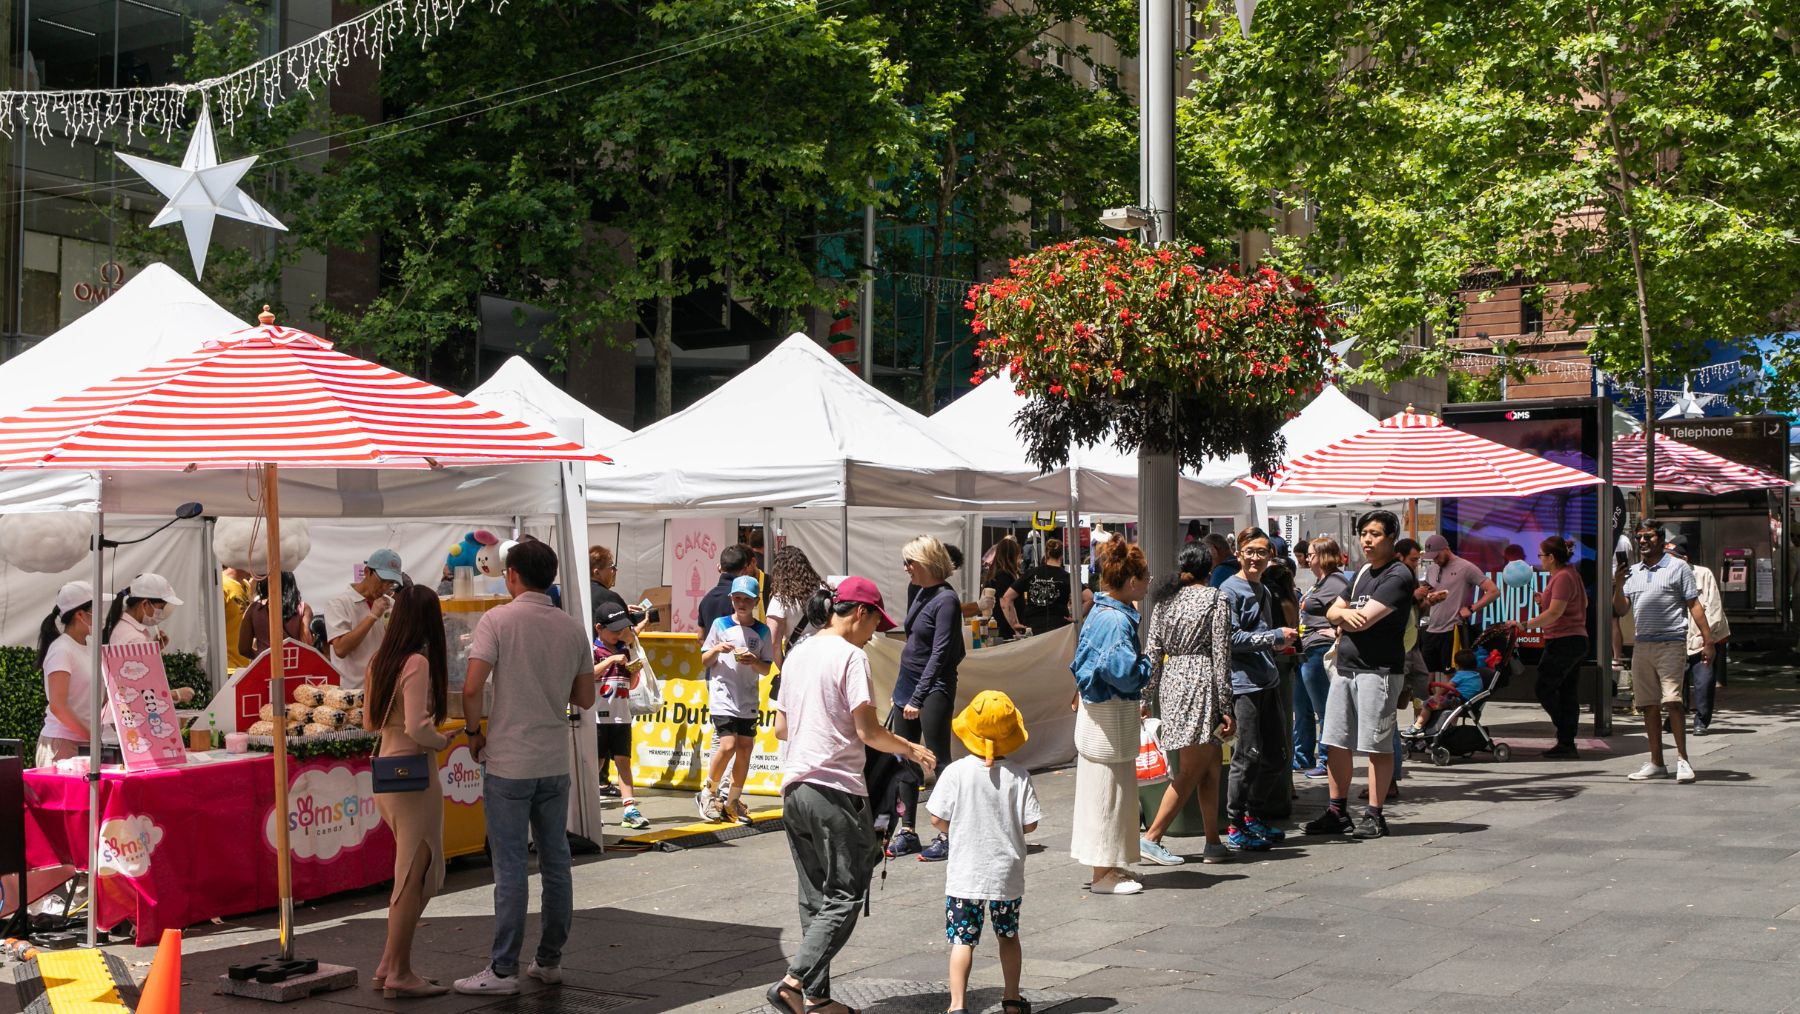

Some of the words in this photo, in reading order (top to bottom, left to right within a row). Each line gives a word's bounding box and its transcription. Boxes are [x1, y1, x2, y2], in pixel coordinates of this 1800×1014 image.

[73, 281, 118, 304] OM
[1671, 427, 1734, 440] Telephone
[674, 530, 718, 560] CAKES
[672, 702, 712, 725] Dut
